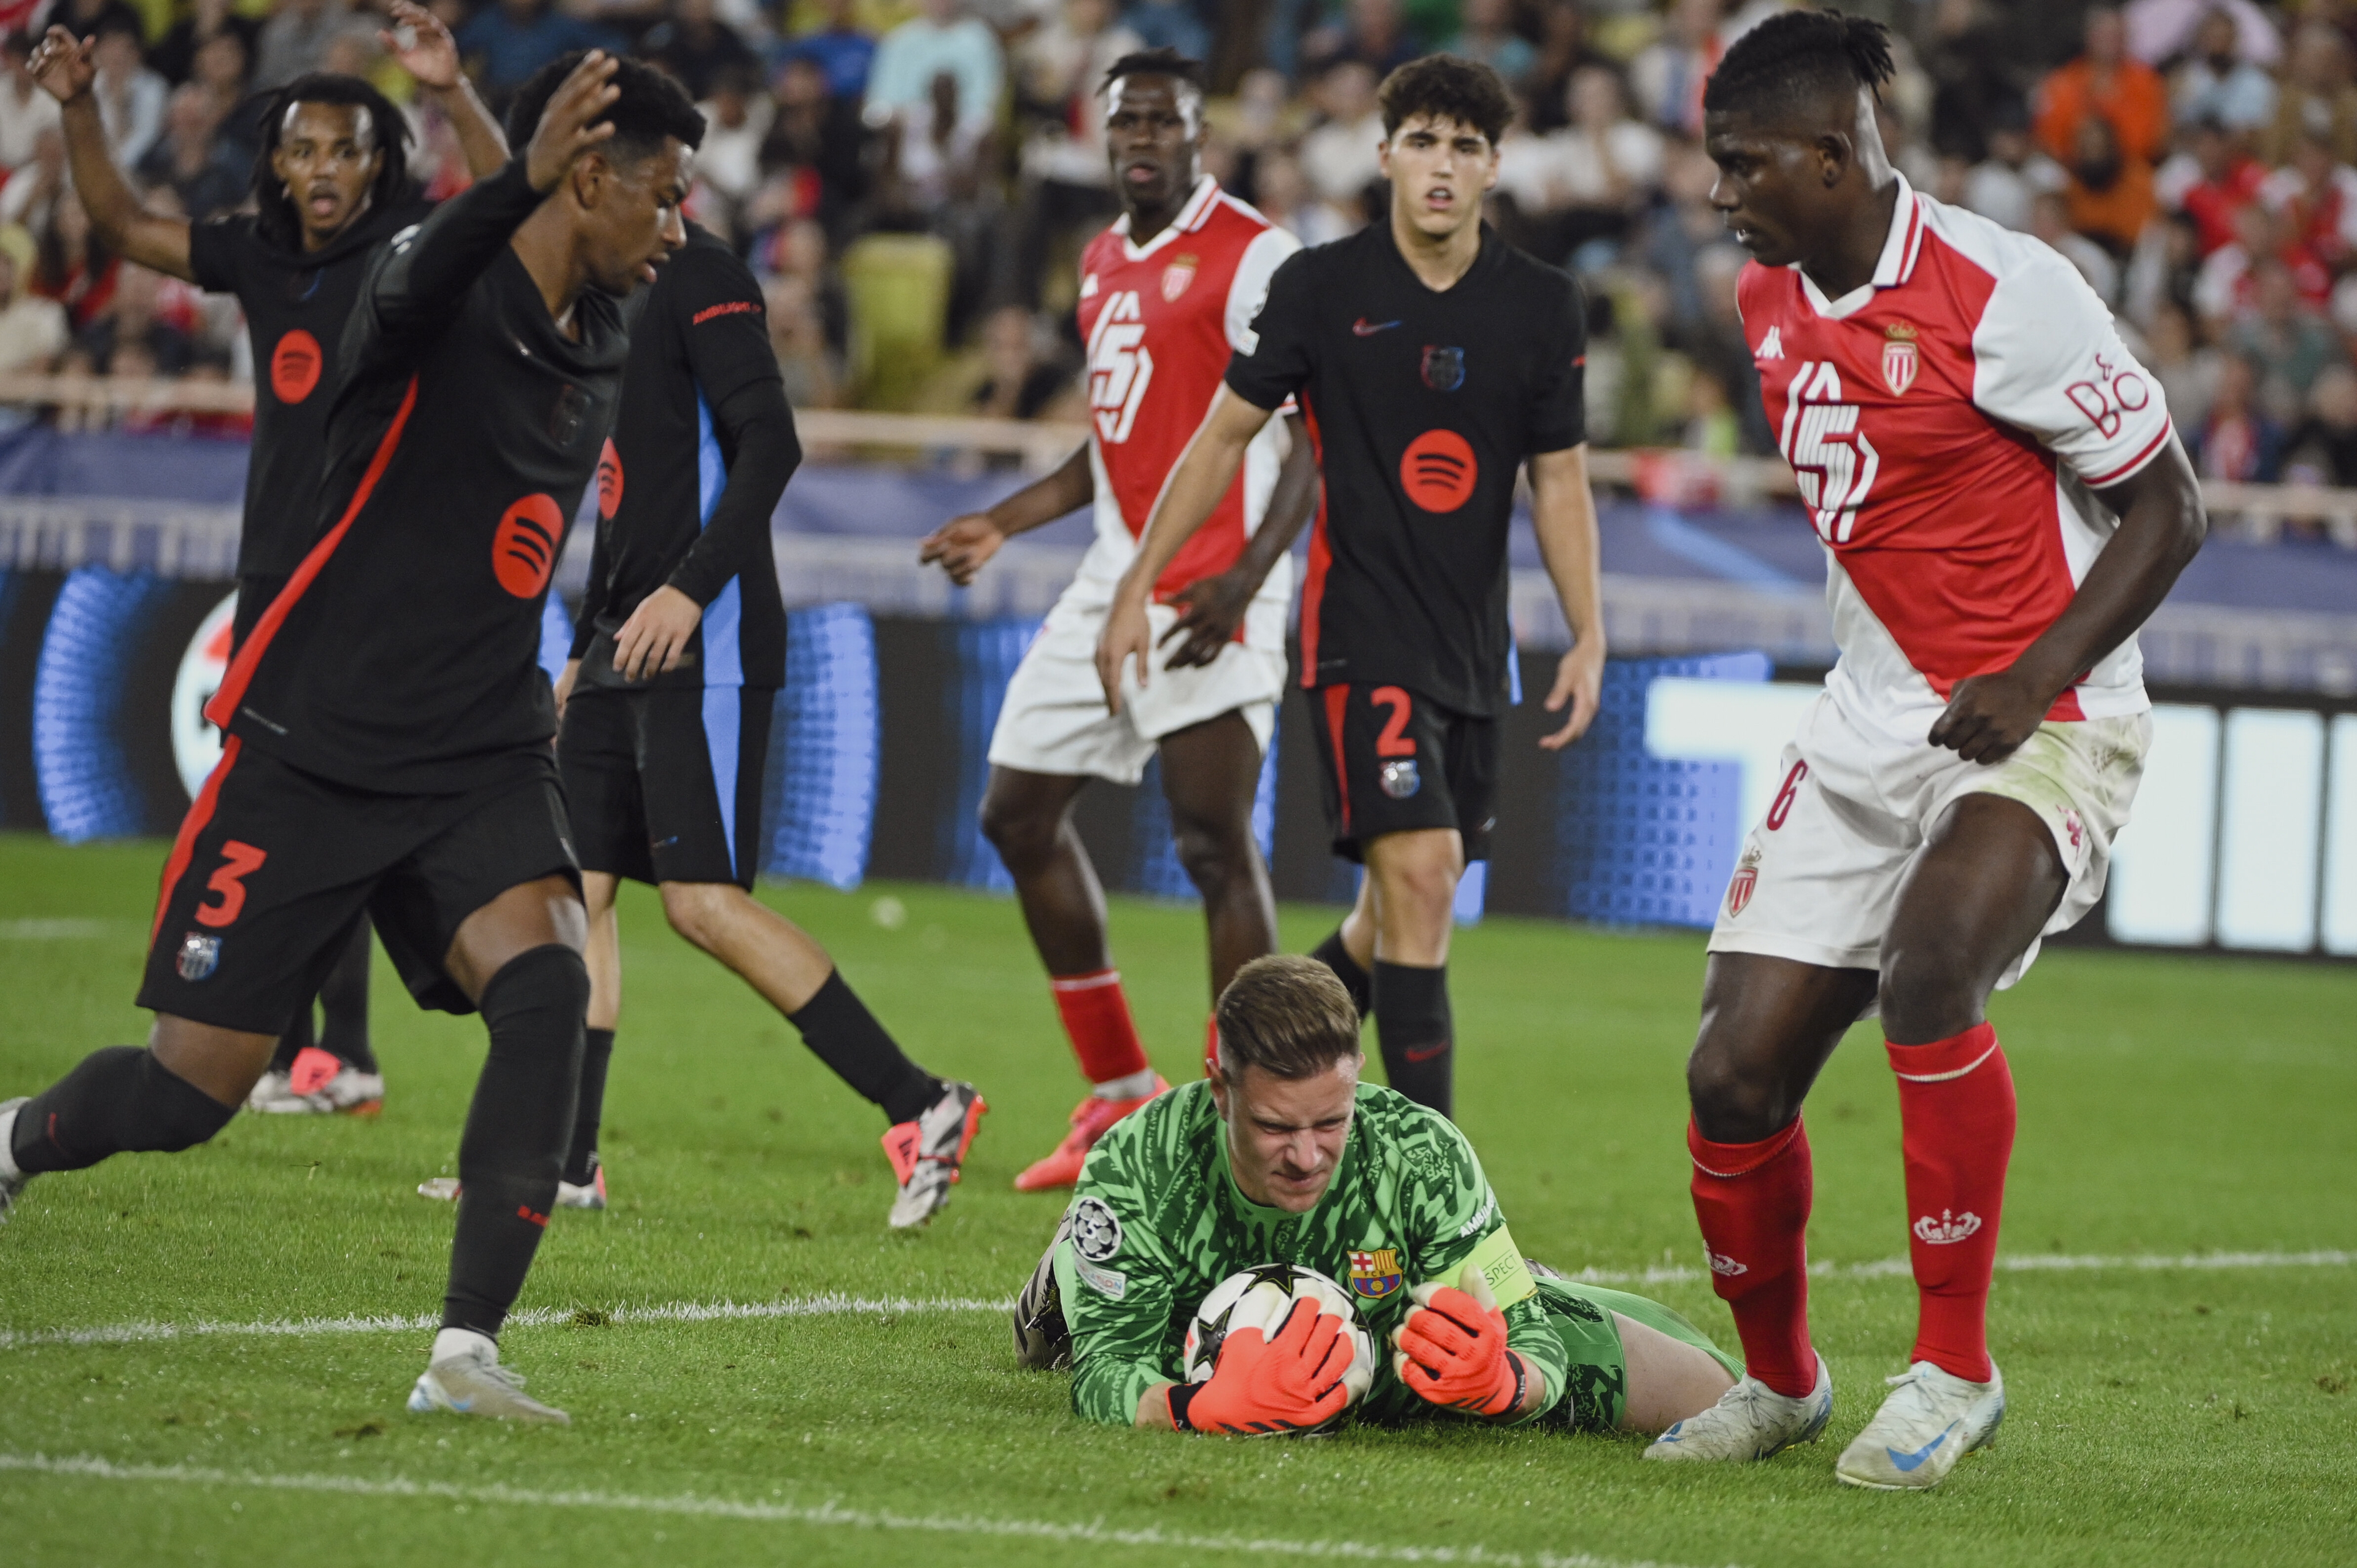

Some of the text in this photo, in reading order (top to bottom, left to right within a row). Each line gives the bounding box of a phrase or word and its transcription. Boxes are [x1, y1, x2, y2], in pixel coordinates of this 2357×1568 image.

[1371, 685, 1417, 757] 2
[1767, 759, 1809, 831] 6
[195, 840, 268, 927] 3
[1085, 1217, 1101, 1239] 5
[1485, 1254, 1518, 1286] SPECT
